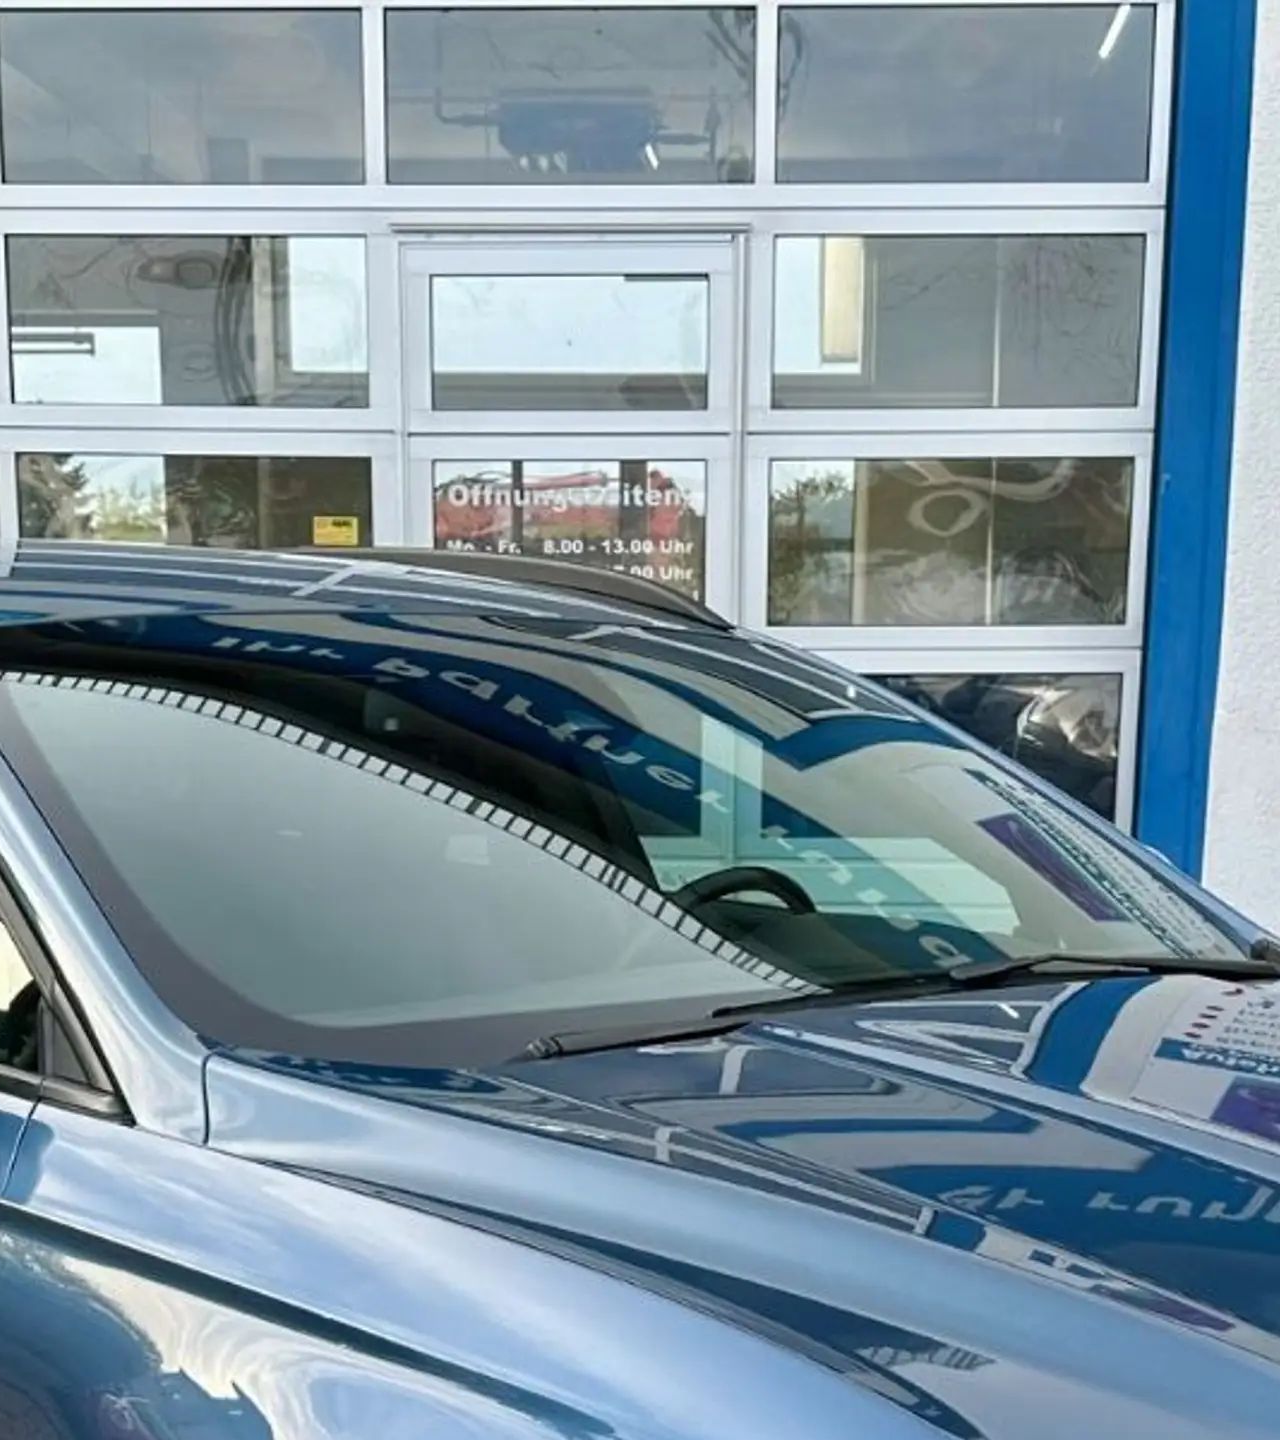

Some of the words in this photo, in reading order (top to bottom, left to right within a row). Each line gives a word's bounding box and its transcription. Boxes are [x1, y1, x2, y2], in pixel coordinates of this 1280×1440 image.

[498, 540, 521, 554] Fr.
[544, 539, 583, 554] 8.00
[601, 539, 654, 554] 13.00
[660, 539, 694, 554] Uhr
